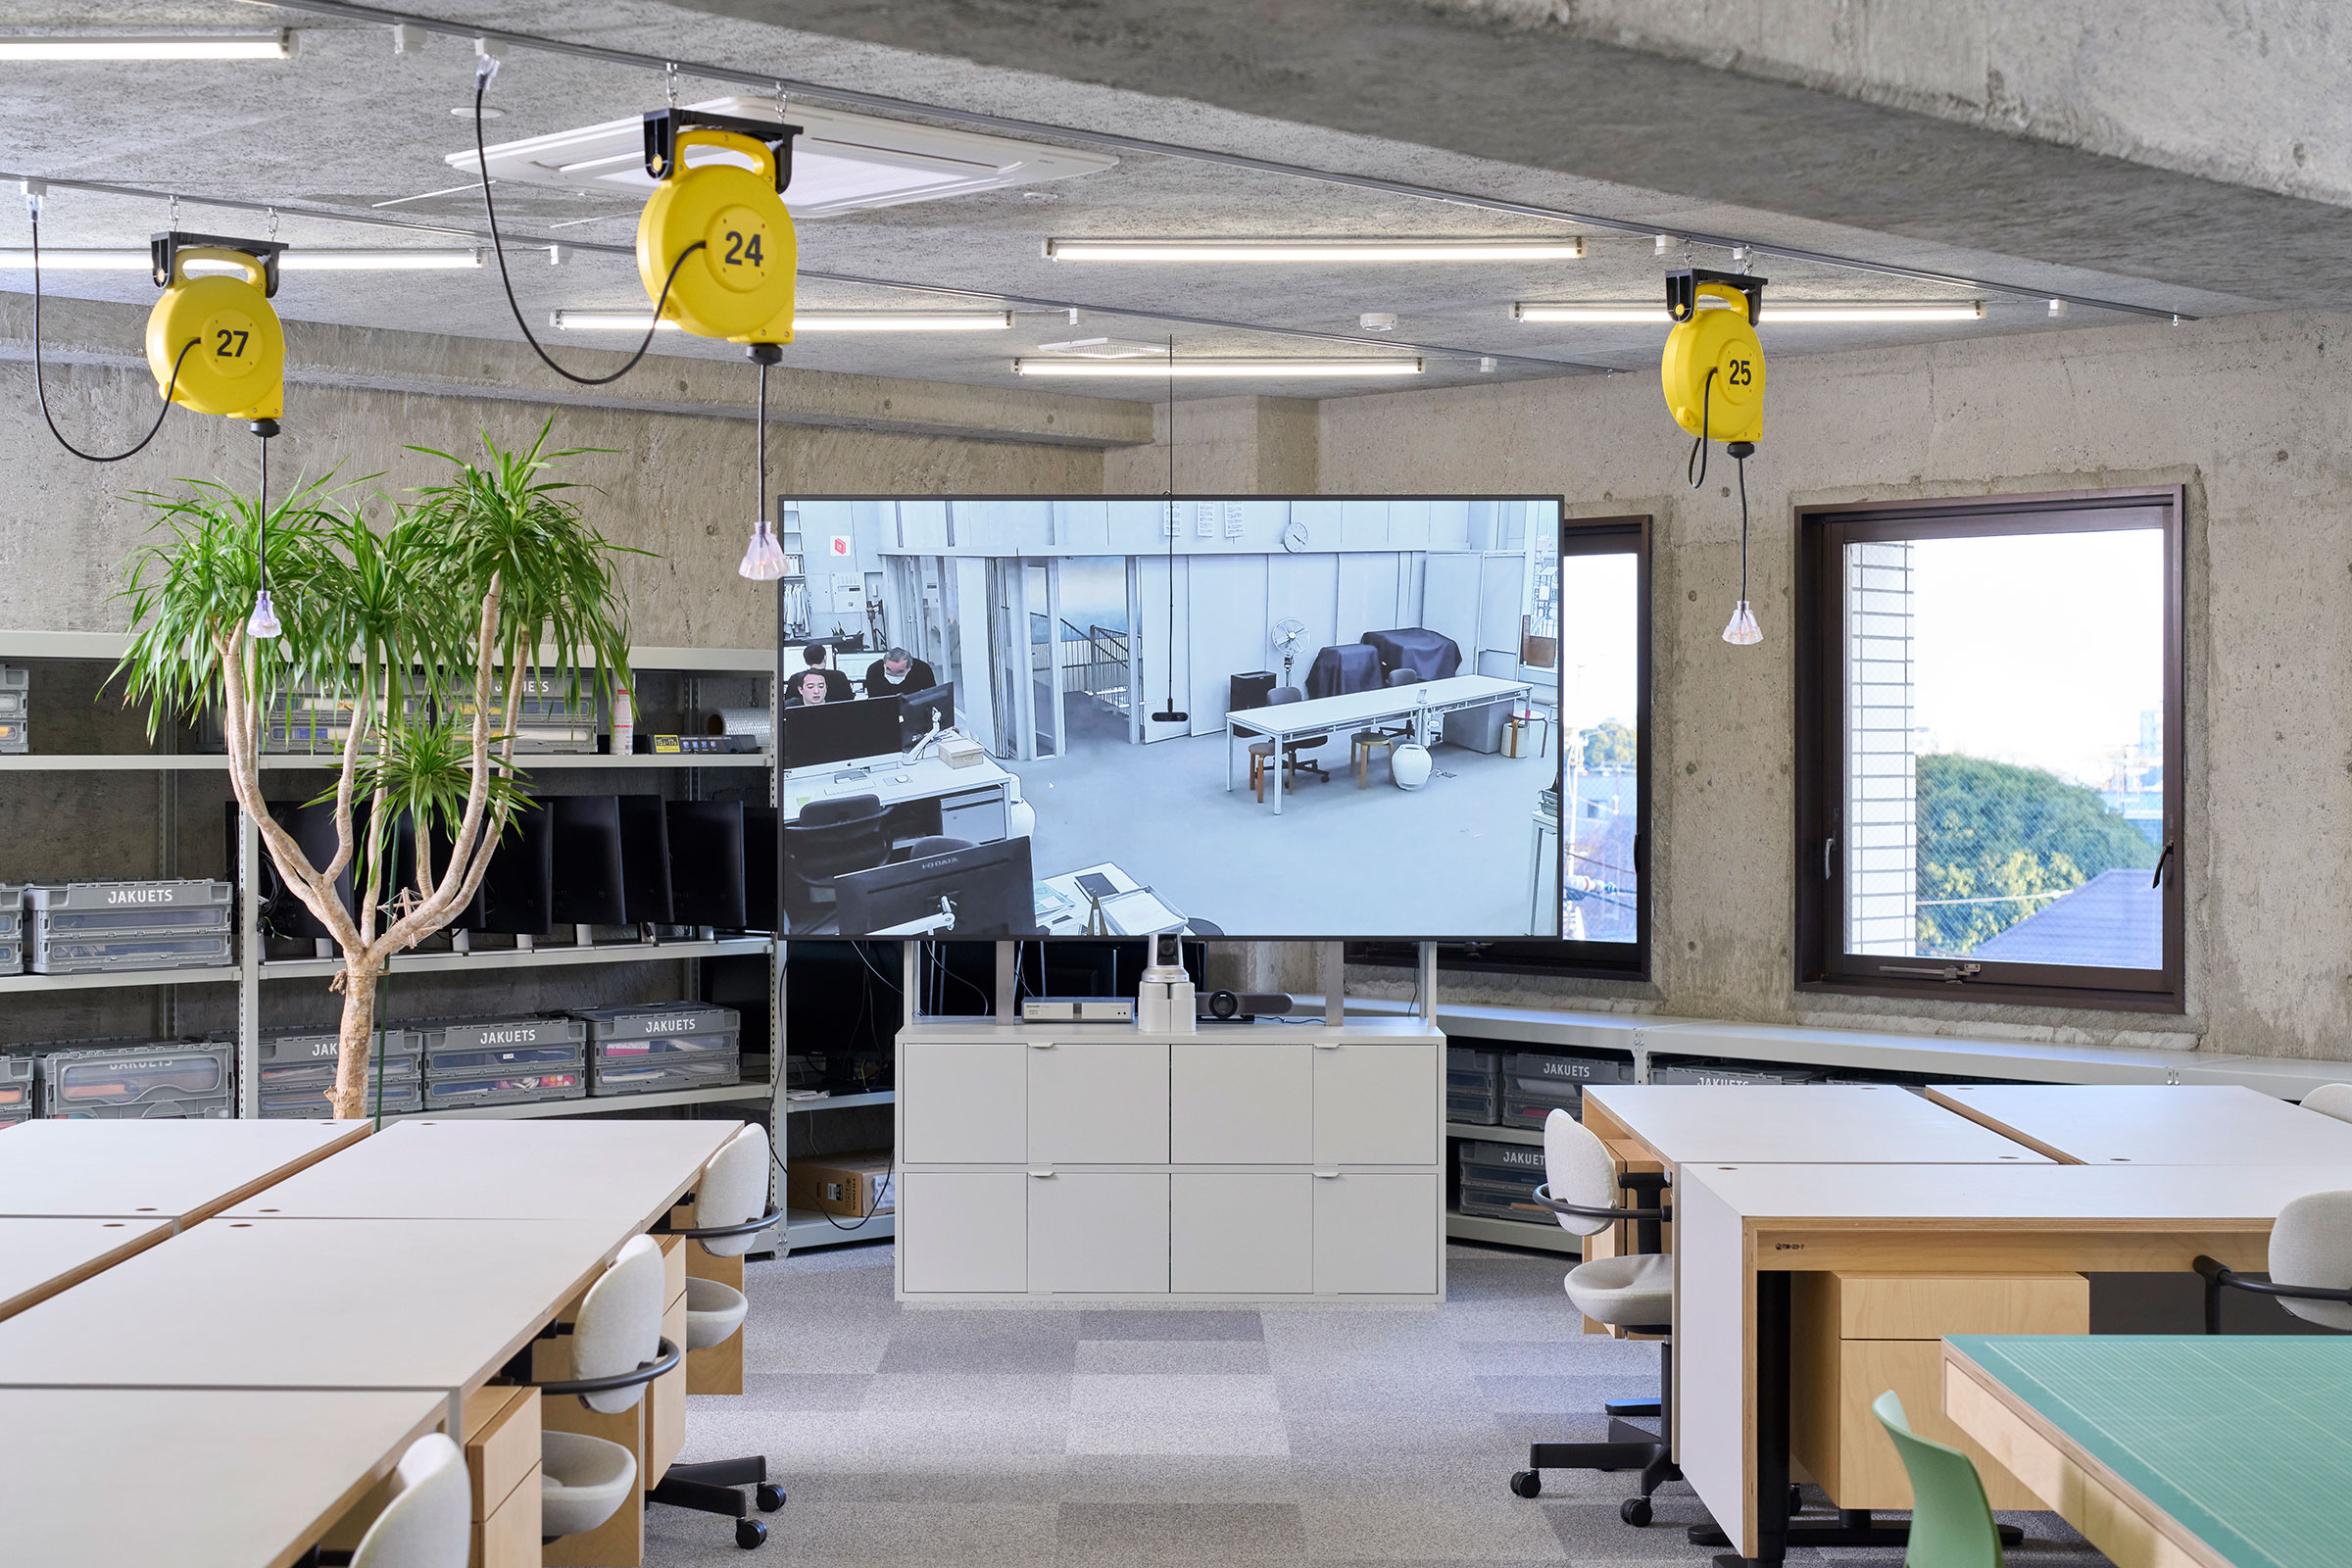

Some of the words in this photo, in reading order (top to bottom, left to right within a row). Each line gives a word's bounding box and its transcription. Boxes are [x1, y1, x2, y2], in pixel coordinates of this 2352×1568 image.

[725, 230, 763, 268] 24
[217, 329, 249, 358] 27
[1730, 359, 1751, 386] 25
[108, 889, 172, 904] JAKUETS
[645, 1018, 696, 1033] JAKUETS
[480, 1029, 536, 1045] JAKUETS
[1544, 1062, 1591, 1078] JAKUETS
[1503, 1152, 1544, 1165] JAKUET
